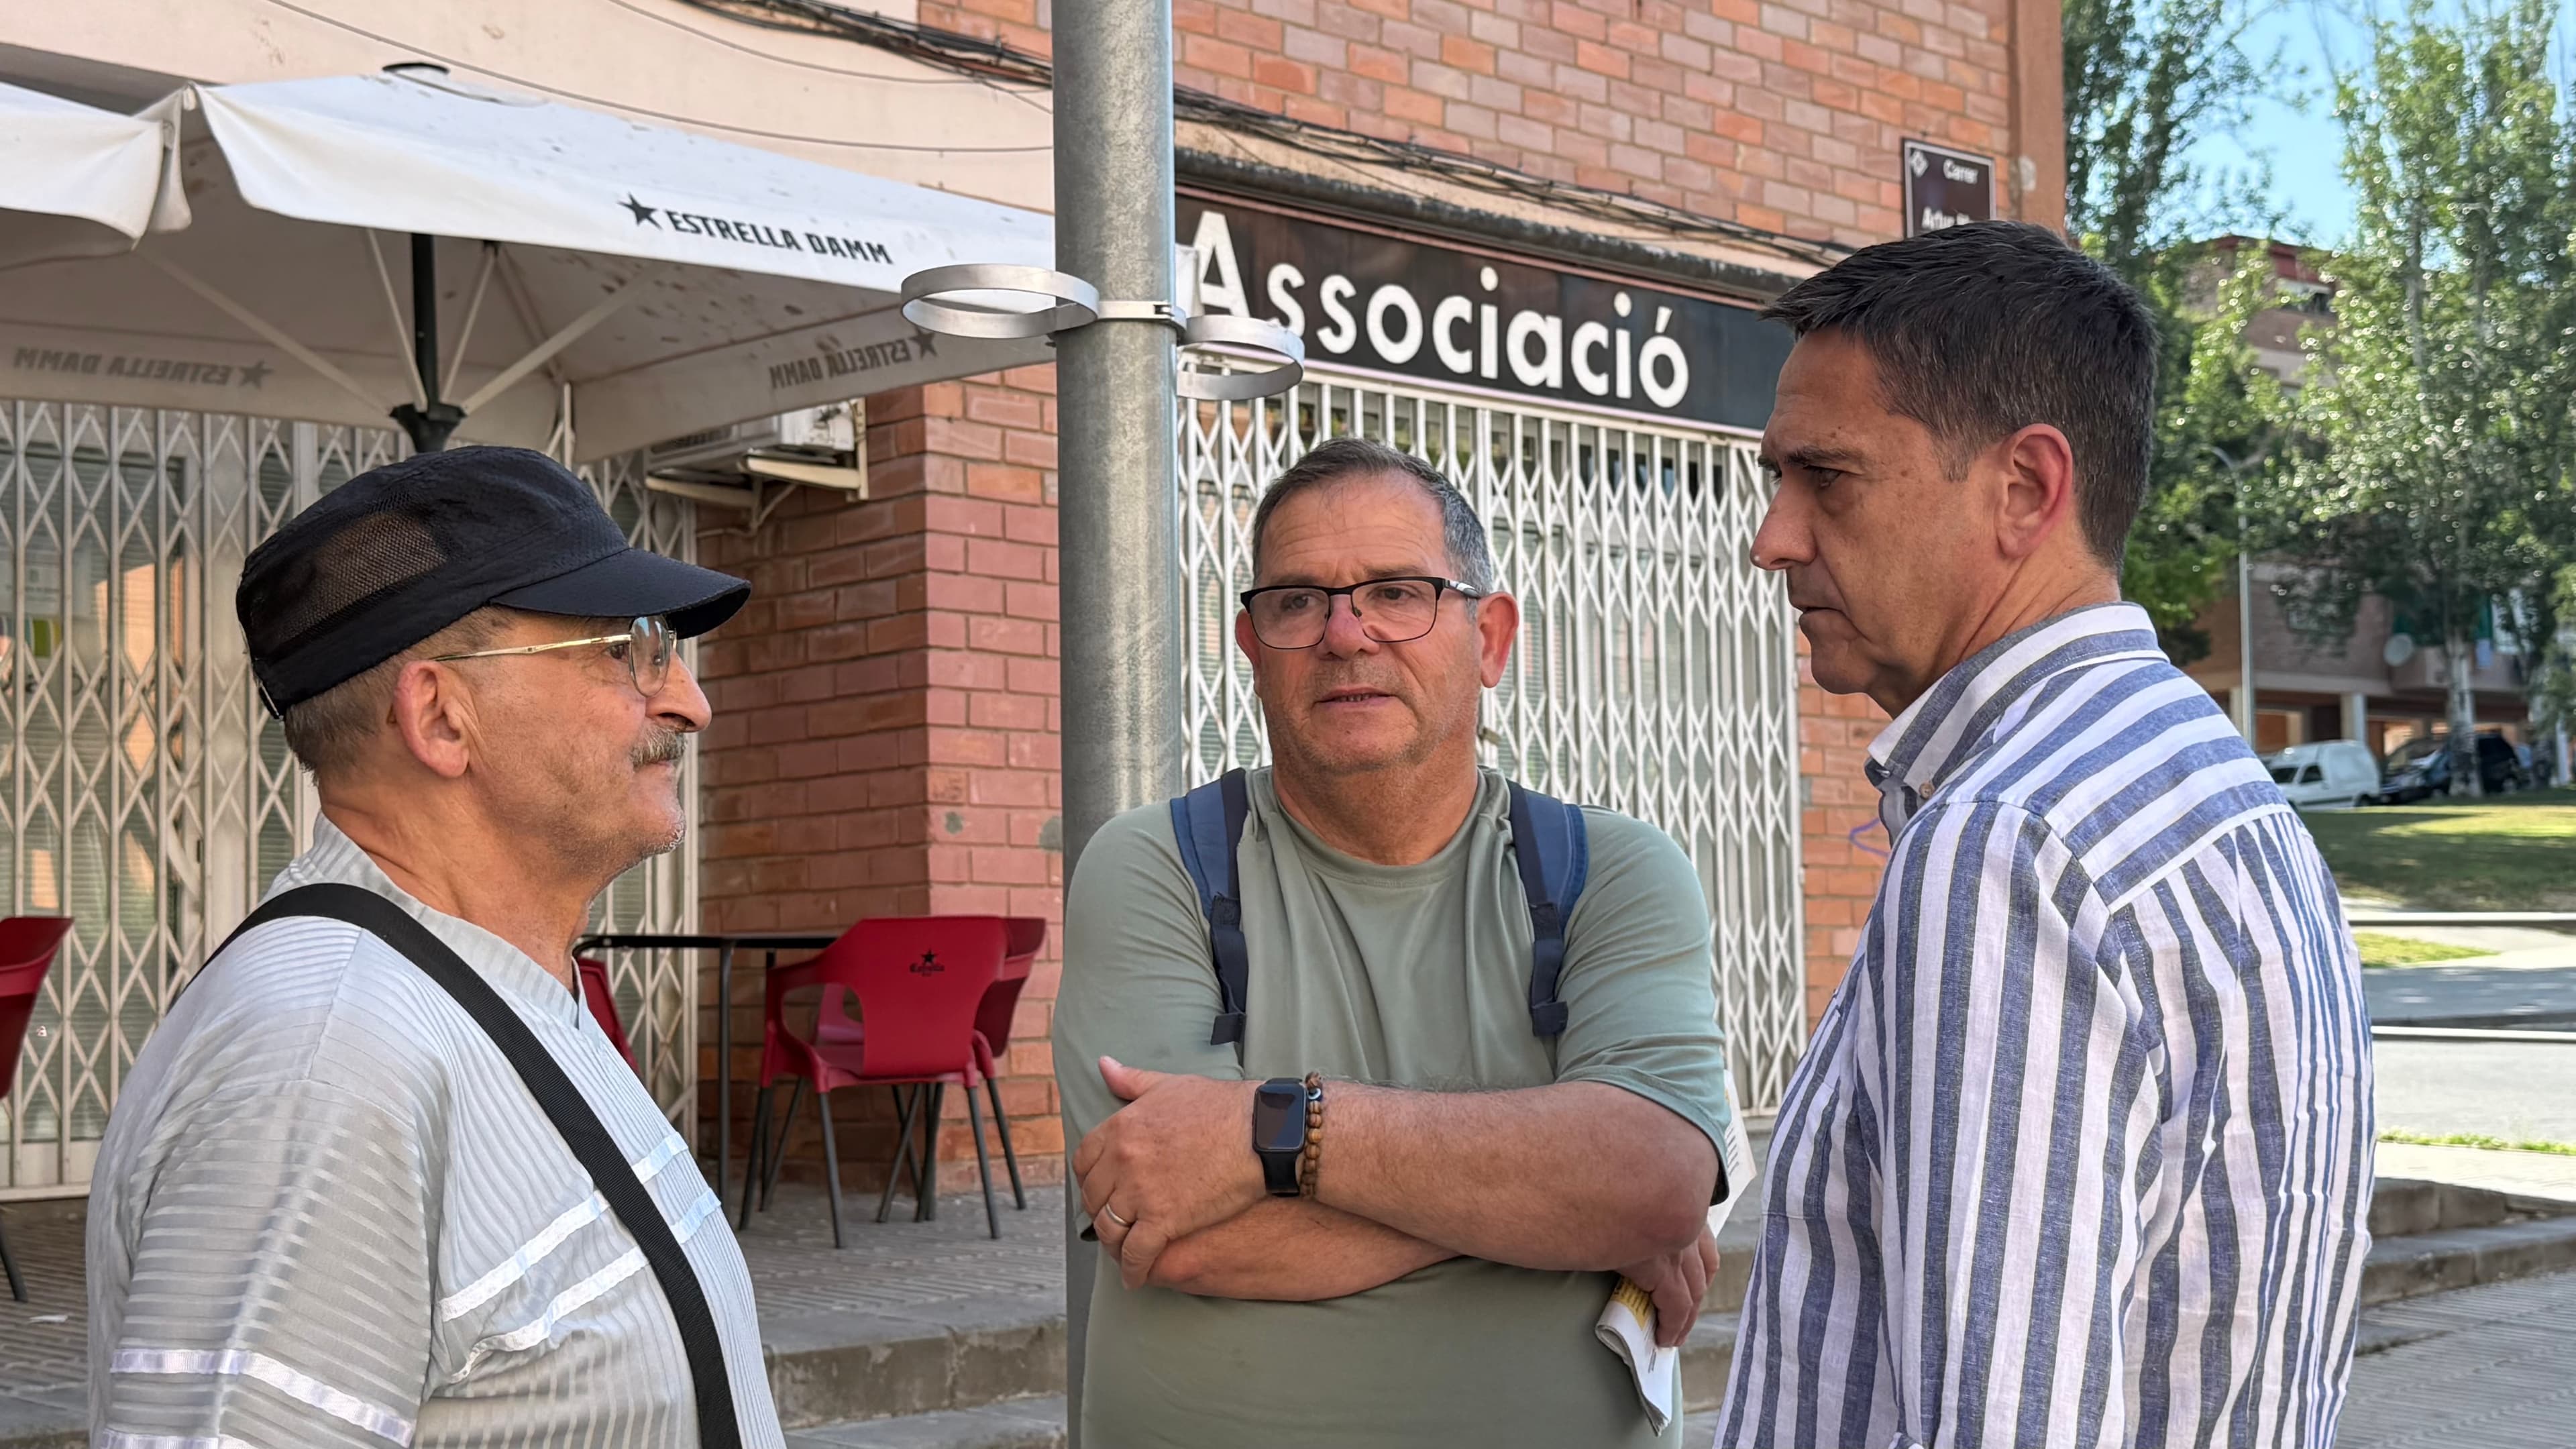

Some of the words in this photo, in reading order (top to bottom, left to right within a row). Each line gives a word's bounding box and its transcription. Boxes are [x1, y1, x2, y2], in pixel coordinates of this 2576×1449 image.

[665, 209, 804, 252] ESTRELLA
[806, 232, 894, 265] DAMM
[1192, 210, 1690, 409] Associació
